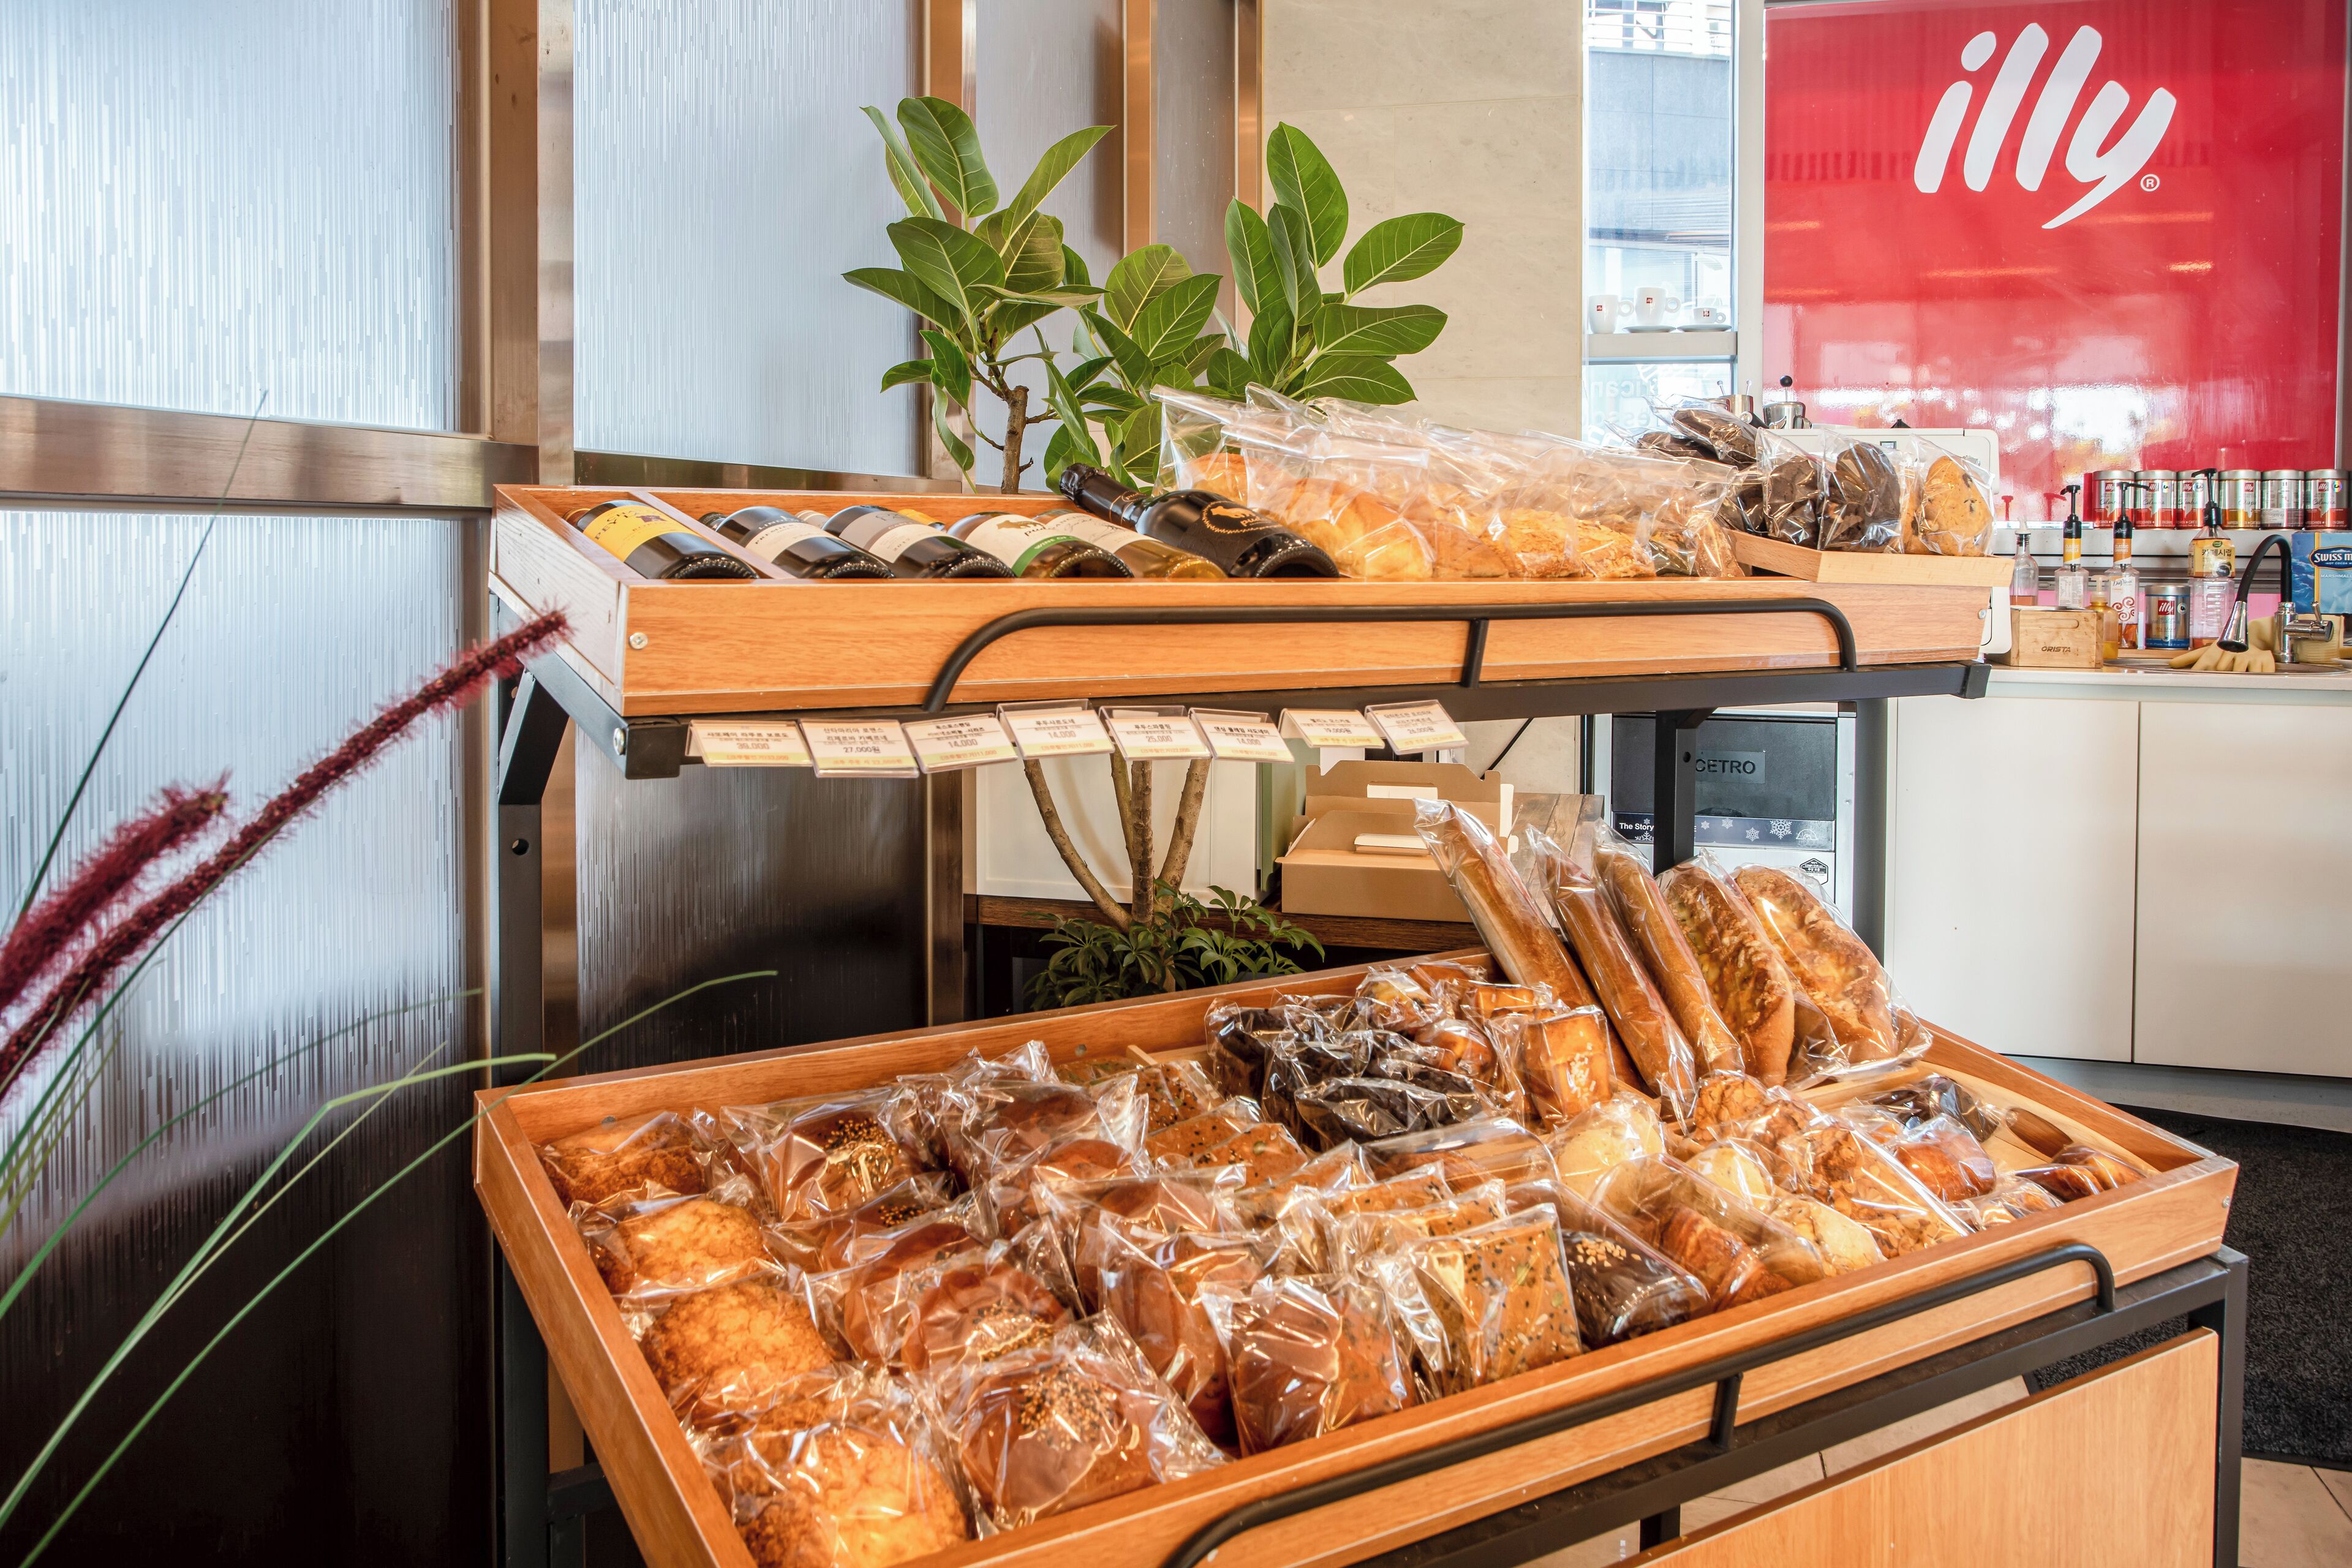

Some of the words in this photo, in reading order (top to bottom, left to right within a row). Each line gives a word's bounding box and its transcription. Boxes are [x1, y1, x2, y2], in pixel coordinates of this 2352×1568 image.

[1913, 22, 2177, 229] illy
[2318, 483, 2328, 491] illy
[2314, 553, 2342, 563] SWISS
[2158, 602, 2174, 615] illy
[1695, 758, 1755, 774] CETRO
